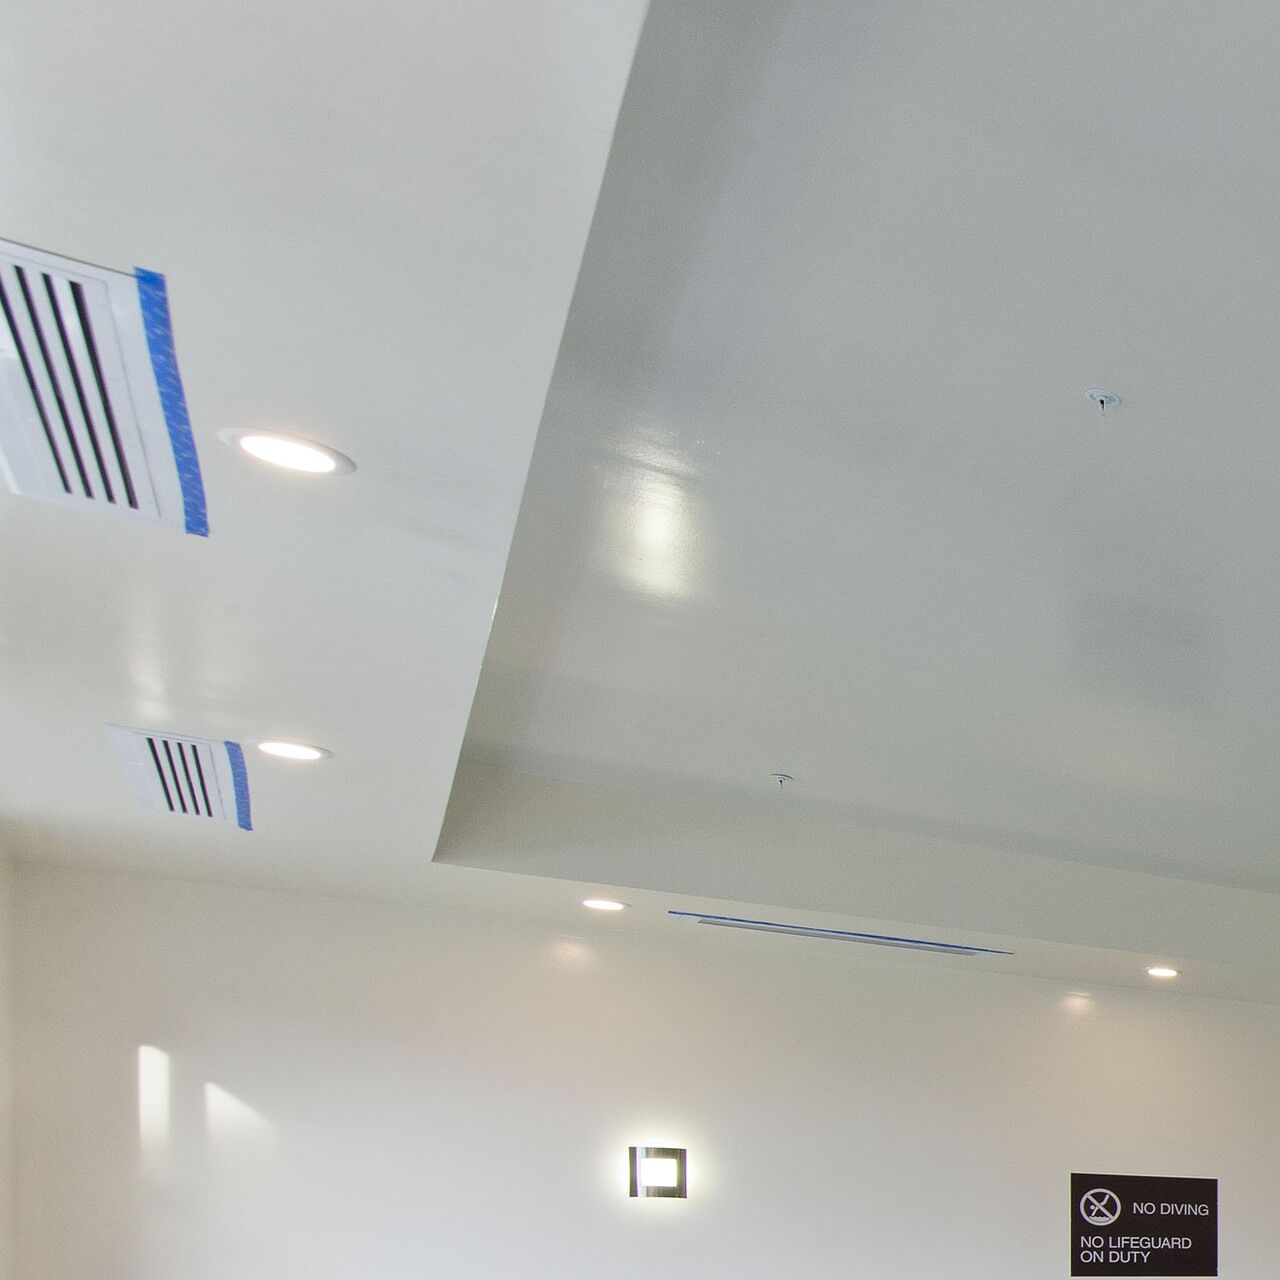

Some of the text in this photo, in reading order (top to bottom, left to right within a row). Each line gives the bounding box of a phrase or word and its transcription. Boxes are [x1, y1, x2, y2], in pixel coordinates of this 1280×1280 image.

[1133, 1202, 1209, 1216] NO DIVING
[1080, 1236, 1192, 1249] NO LIFEGUARD
[1080, 1251, 1151, 1263] ON DUTY
